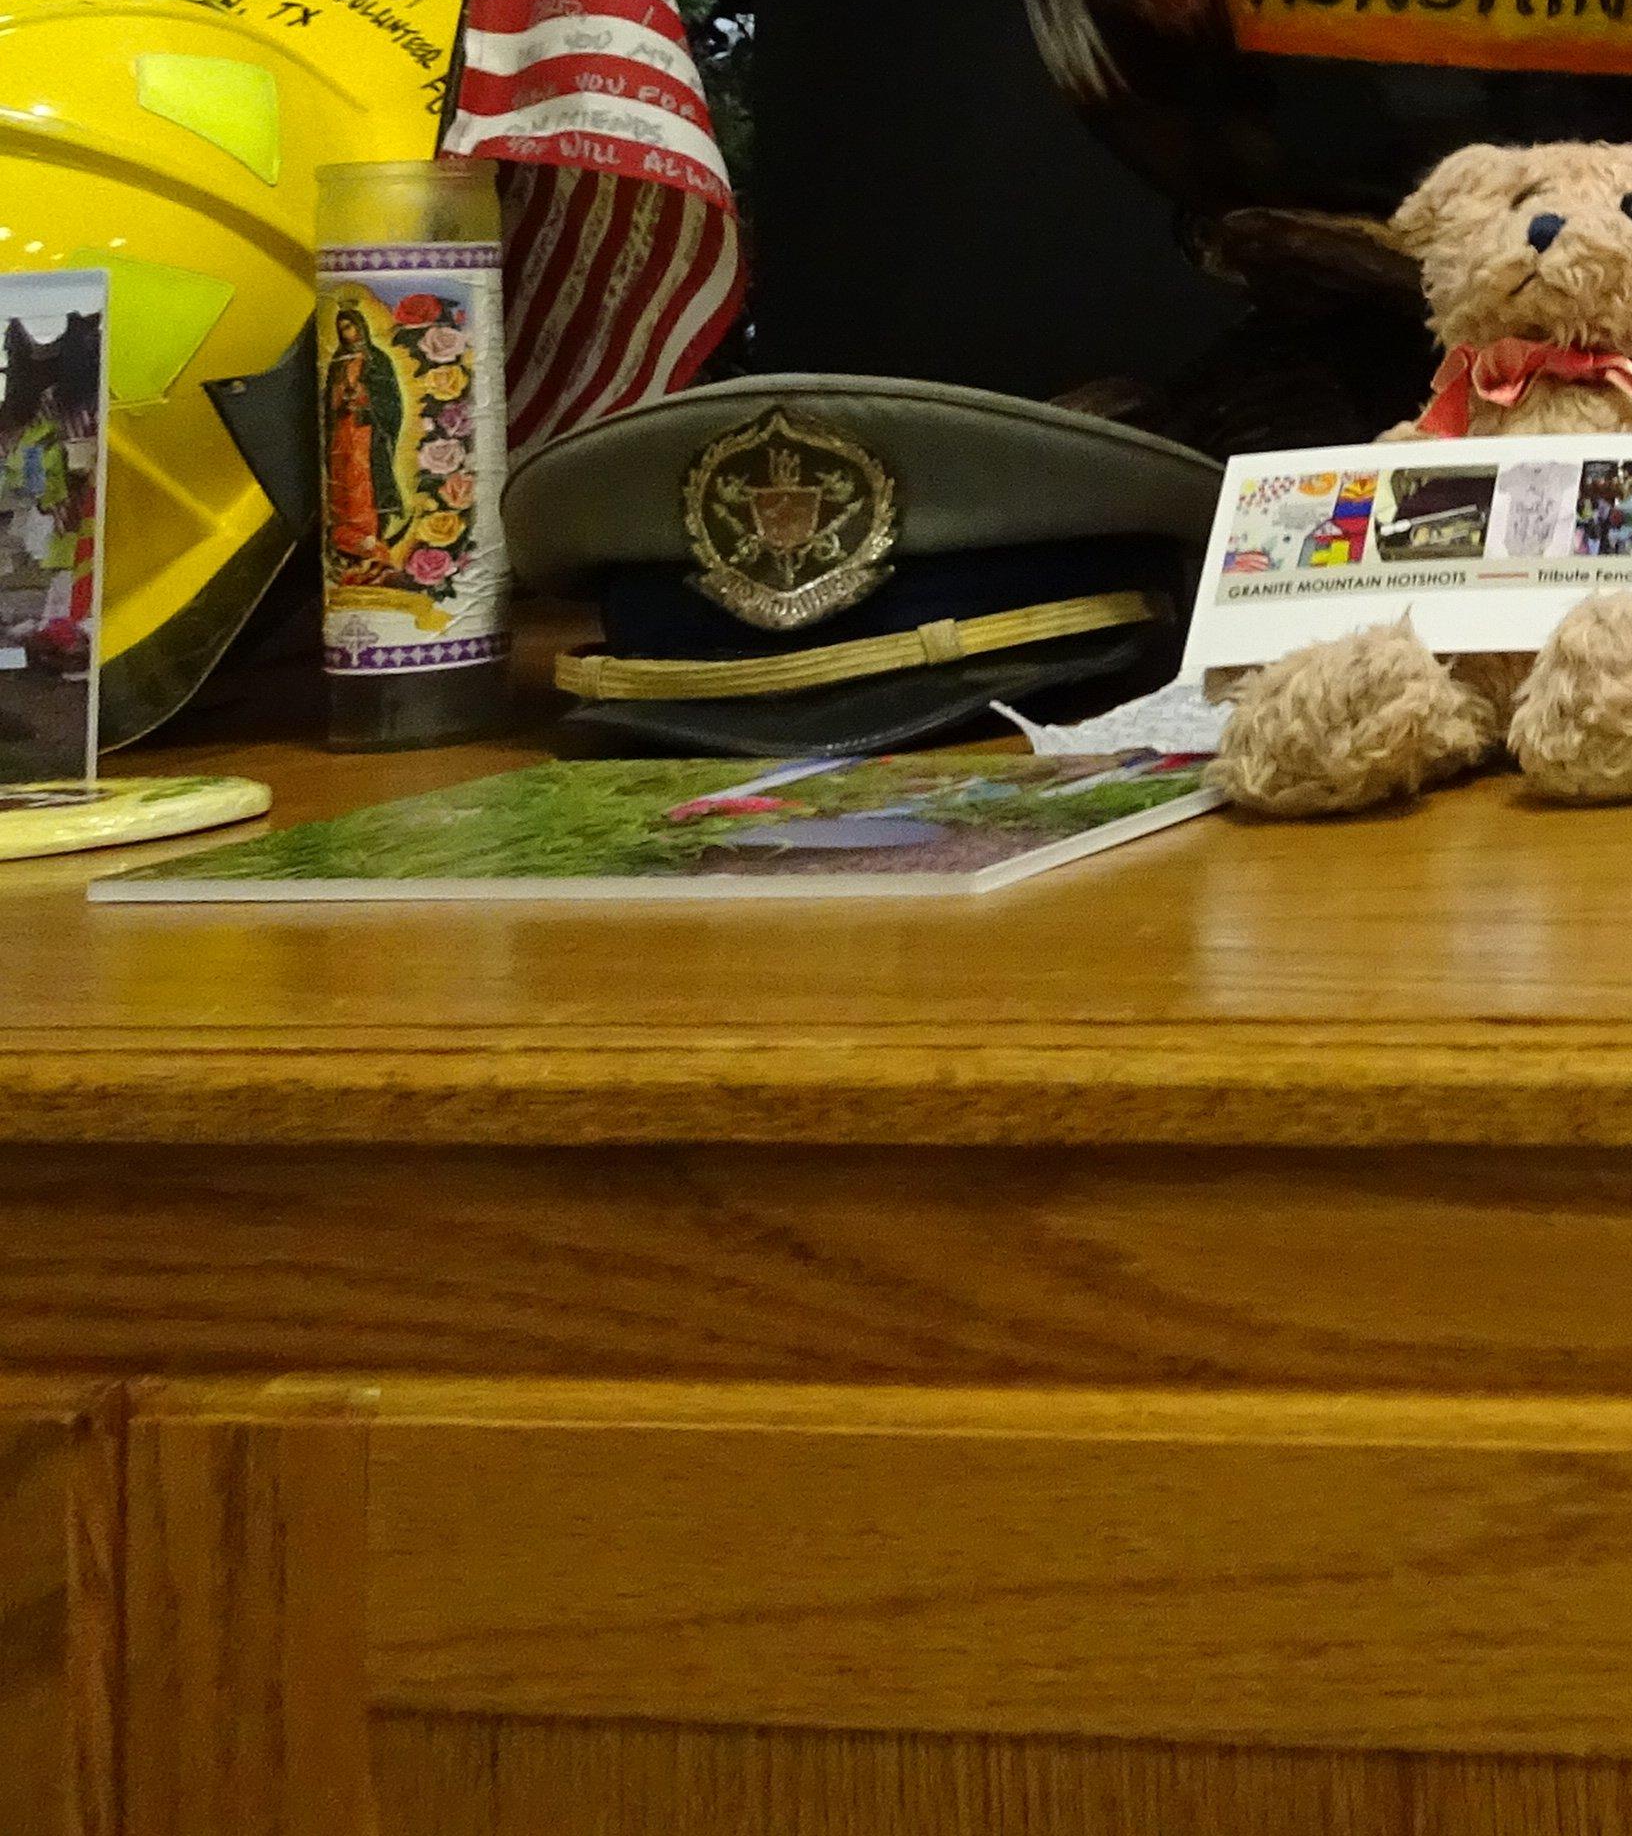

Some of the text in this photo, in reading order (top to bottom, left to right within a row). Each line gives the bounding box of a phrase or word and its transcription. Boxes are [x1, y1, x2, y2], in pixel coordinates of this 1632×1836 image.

[267, 0, 323, 27] TX
[1227, 579, 1293, 599] GRANITE
[1297, 575, 1382, 594] MOUNTAIN
[1385, 570, 1467, 588] HOTSHOTS
[1537, 568, 1591, 583] Tribute
